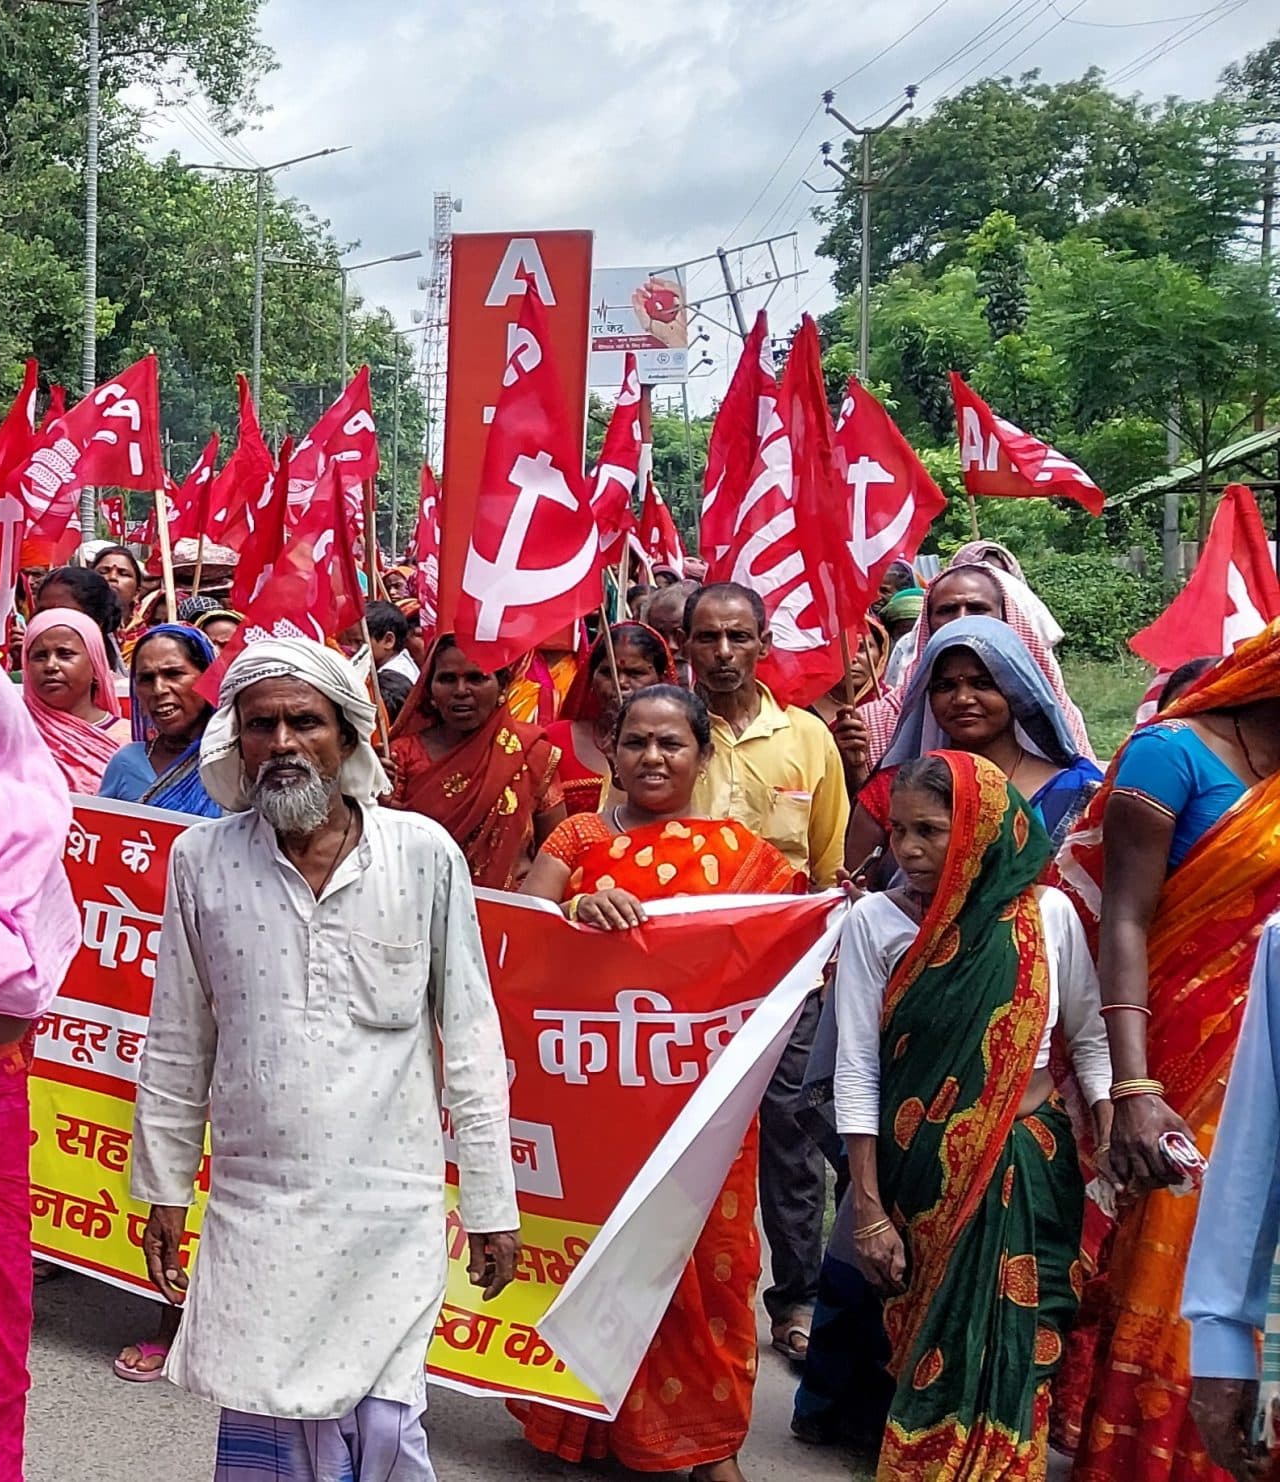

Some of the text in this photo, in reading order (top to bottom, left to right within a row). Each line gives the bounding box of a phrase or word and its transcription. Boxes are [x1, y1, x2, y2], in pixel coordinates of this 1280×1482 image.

[121, 830, 157, 873] के
[56, 1114, 133, 1172] सह
[31, 1184, 119, 1240] नके
